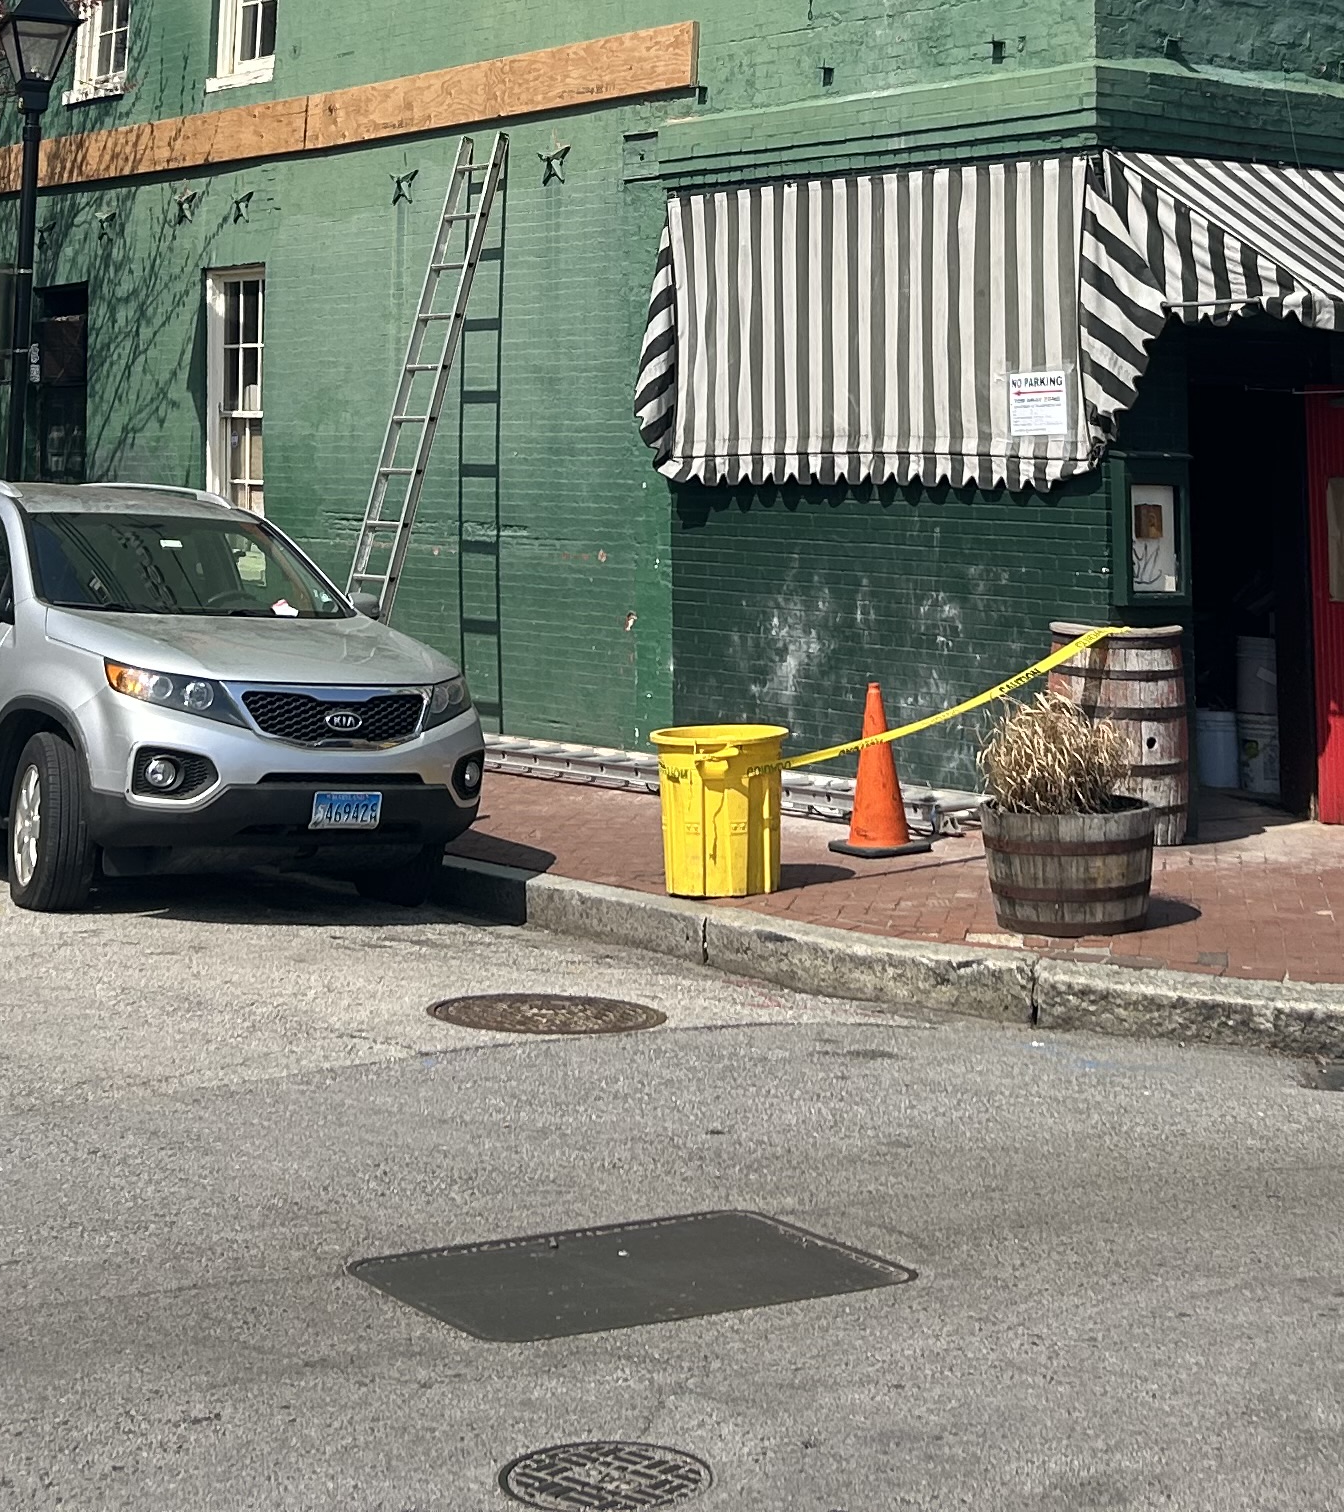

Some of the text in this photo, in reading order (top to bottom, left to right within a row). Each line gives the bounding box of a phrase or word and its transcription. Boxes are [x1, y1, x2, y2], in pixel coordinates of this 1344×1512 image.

[1012, 376, 1062, 388] NO PARKING
[998, 668, 1041, 693] CAUTION
[333, 716, 355, 726] KIA
